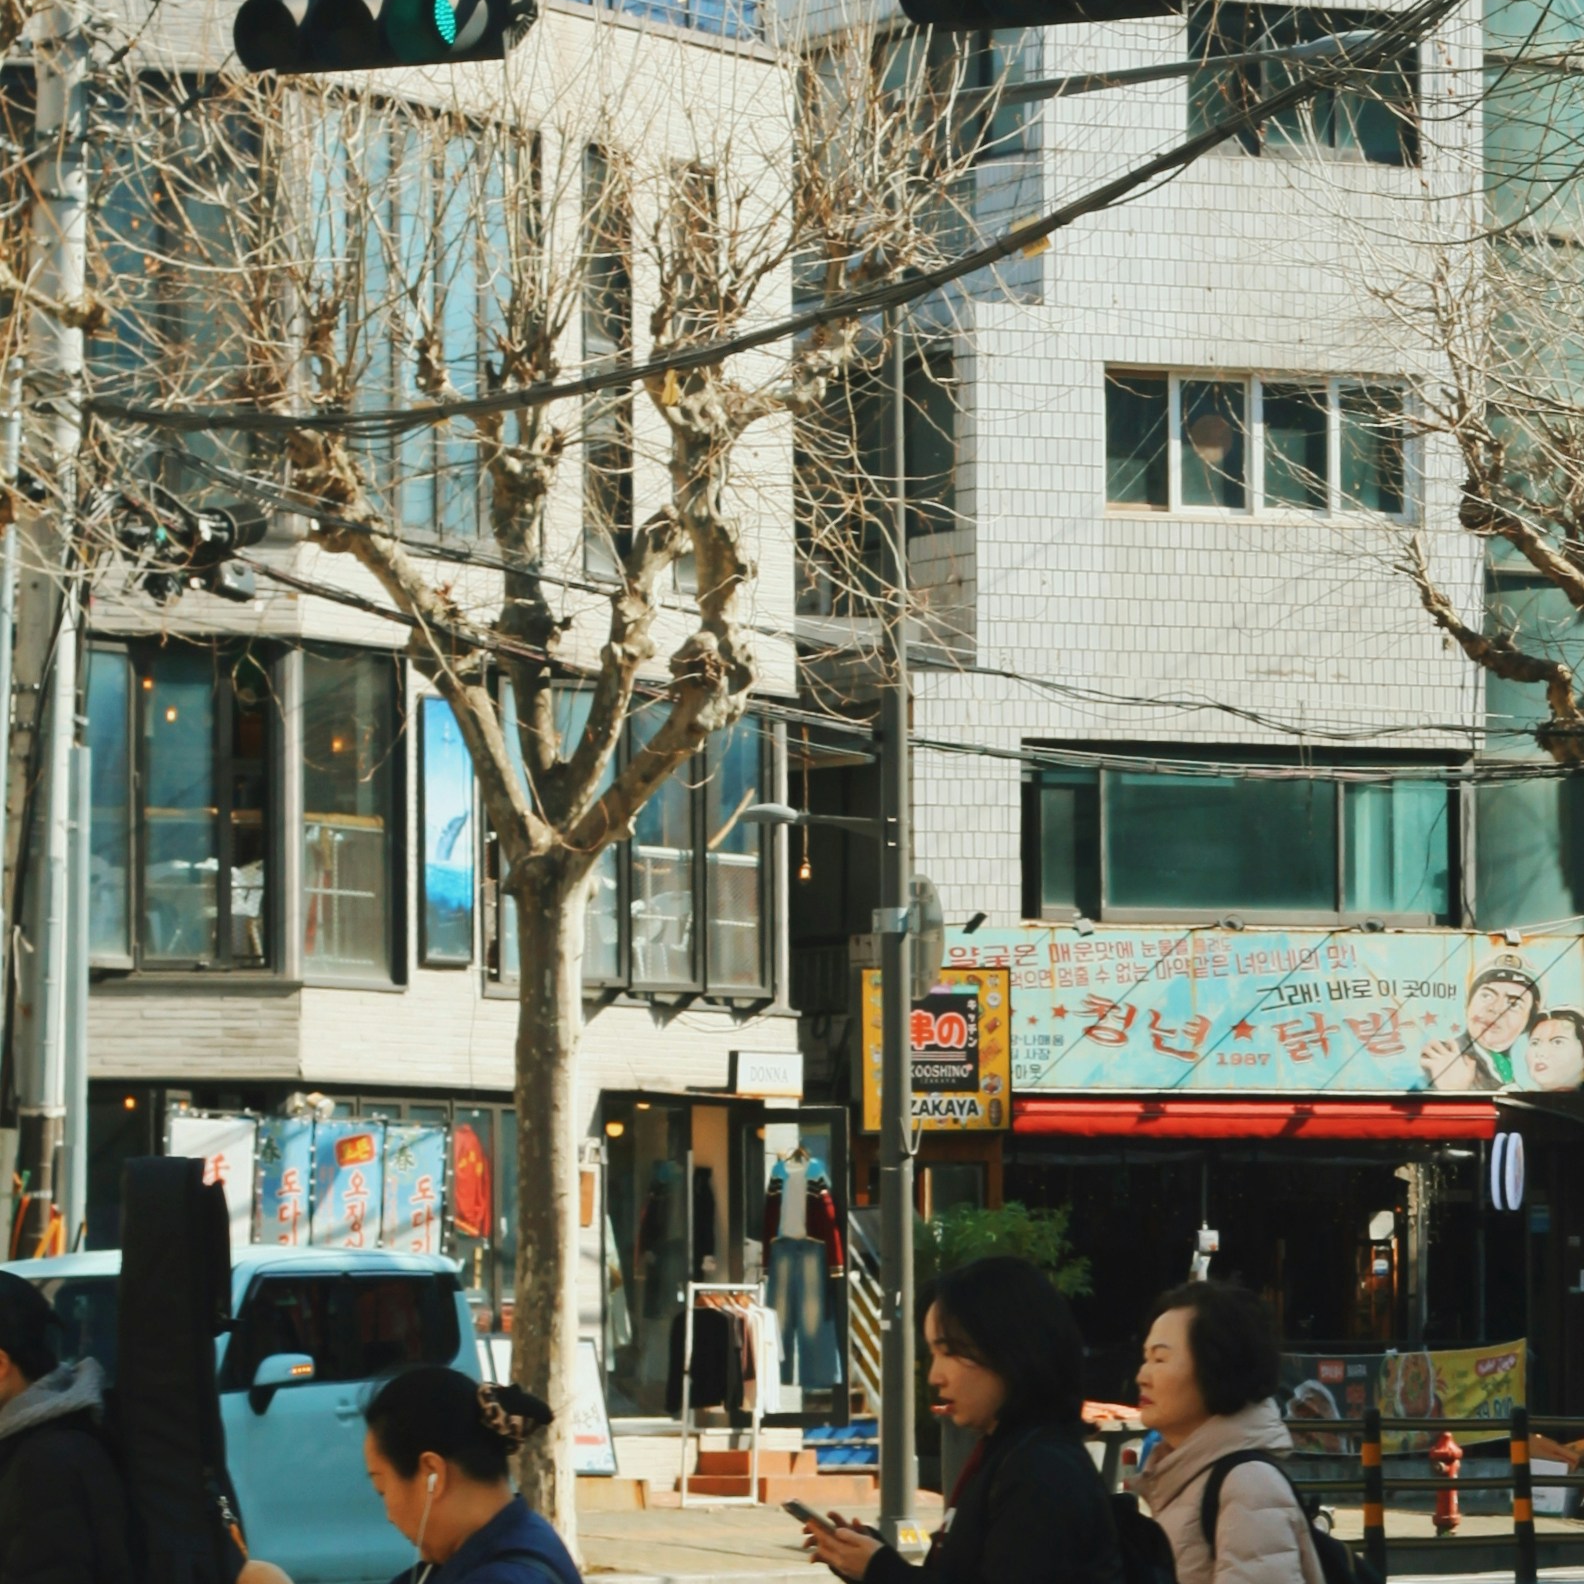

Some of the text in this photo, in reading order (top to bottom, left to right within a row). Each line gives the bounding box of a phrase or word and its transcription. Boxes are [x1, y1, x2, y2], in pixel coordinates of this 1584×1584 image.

[1048, 941, 1134, 963] 매운맛에
[1096, 968, 1110, 984] 수
[1116, 963, 1150, 985] 없는
[1156, 954, 1229, 980] 마약같은
[1327, 945, 1357, 969] 맛!
[1256, 979, 1457, 1012] 그래! 바로 이 곳이야!
[1074, 993, 1415, 1064] 청년 닭발
[1216, 1052, 1270, 1067] 1987
[750, 1065, 788, 1083] DONNA
